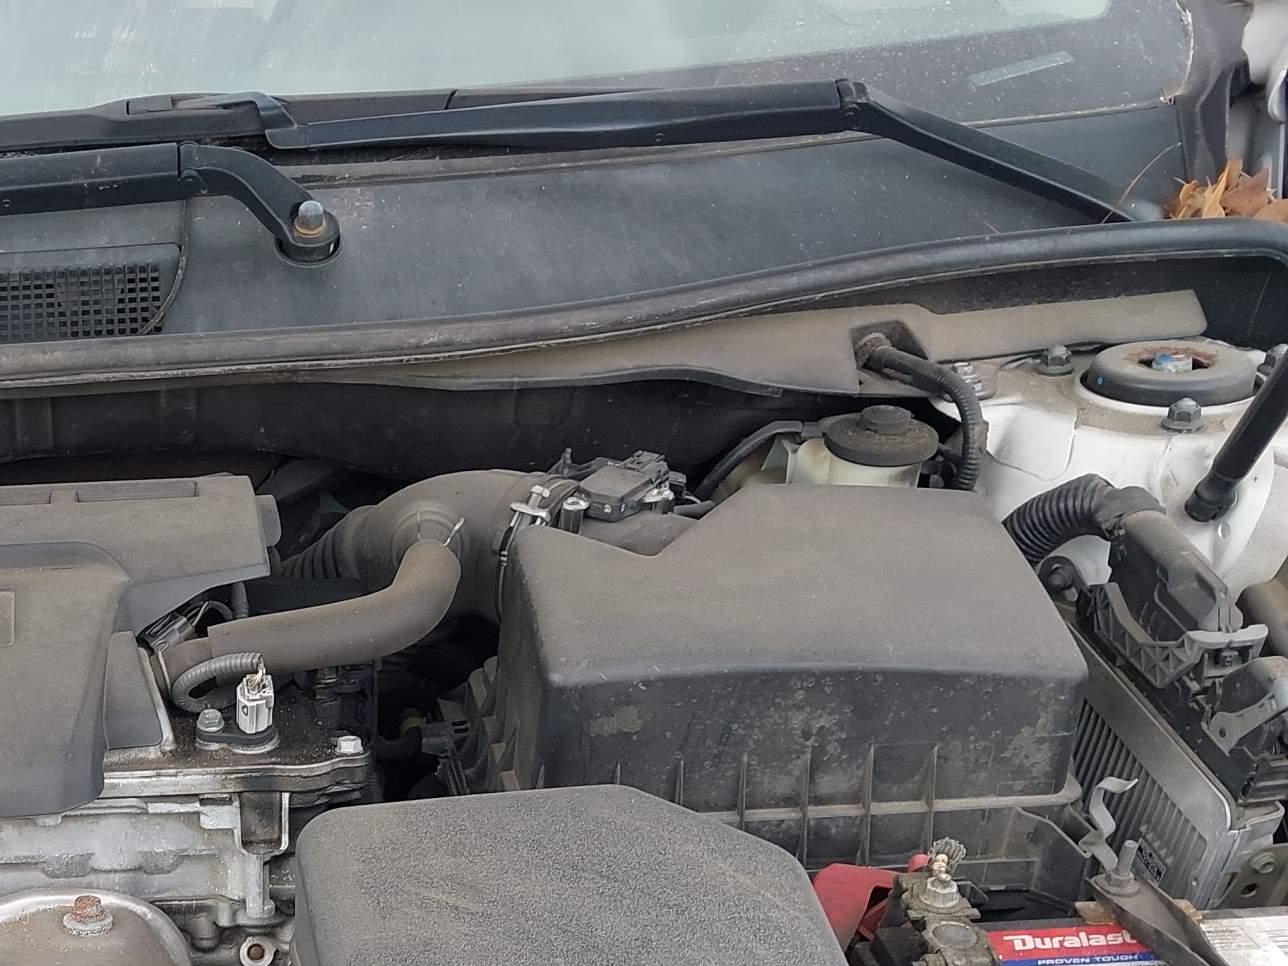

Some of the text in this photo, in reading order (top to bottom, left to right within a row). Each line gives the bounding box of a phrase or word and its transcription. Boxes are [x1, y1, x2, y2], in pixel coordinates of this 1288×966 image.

[1002, 929, 1138, 951] Duralast
[1037, 953, 1139, 966] PROVEN TOUGH
